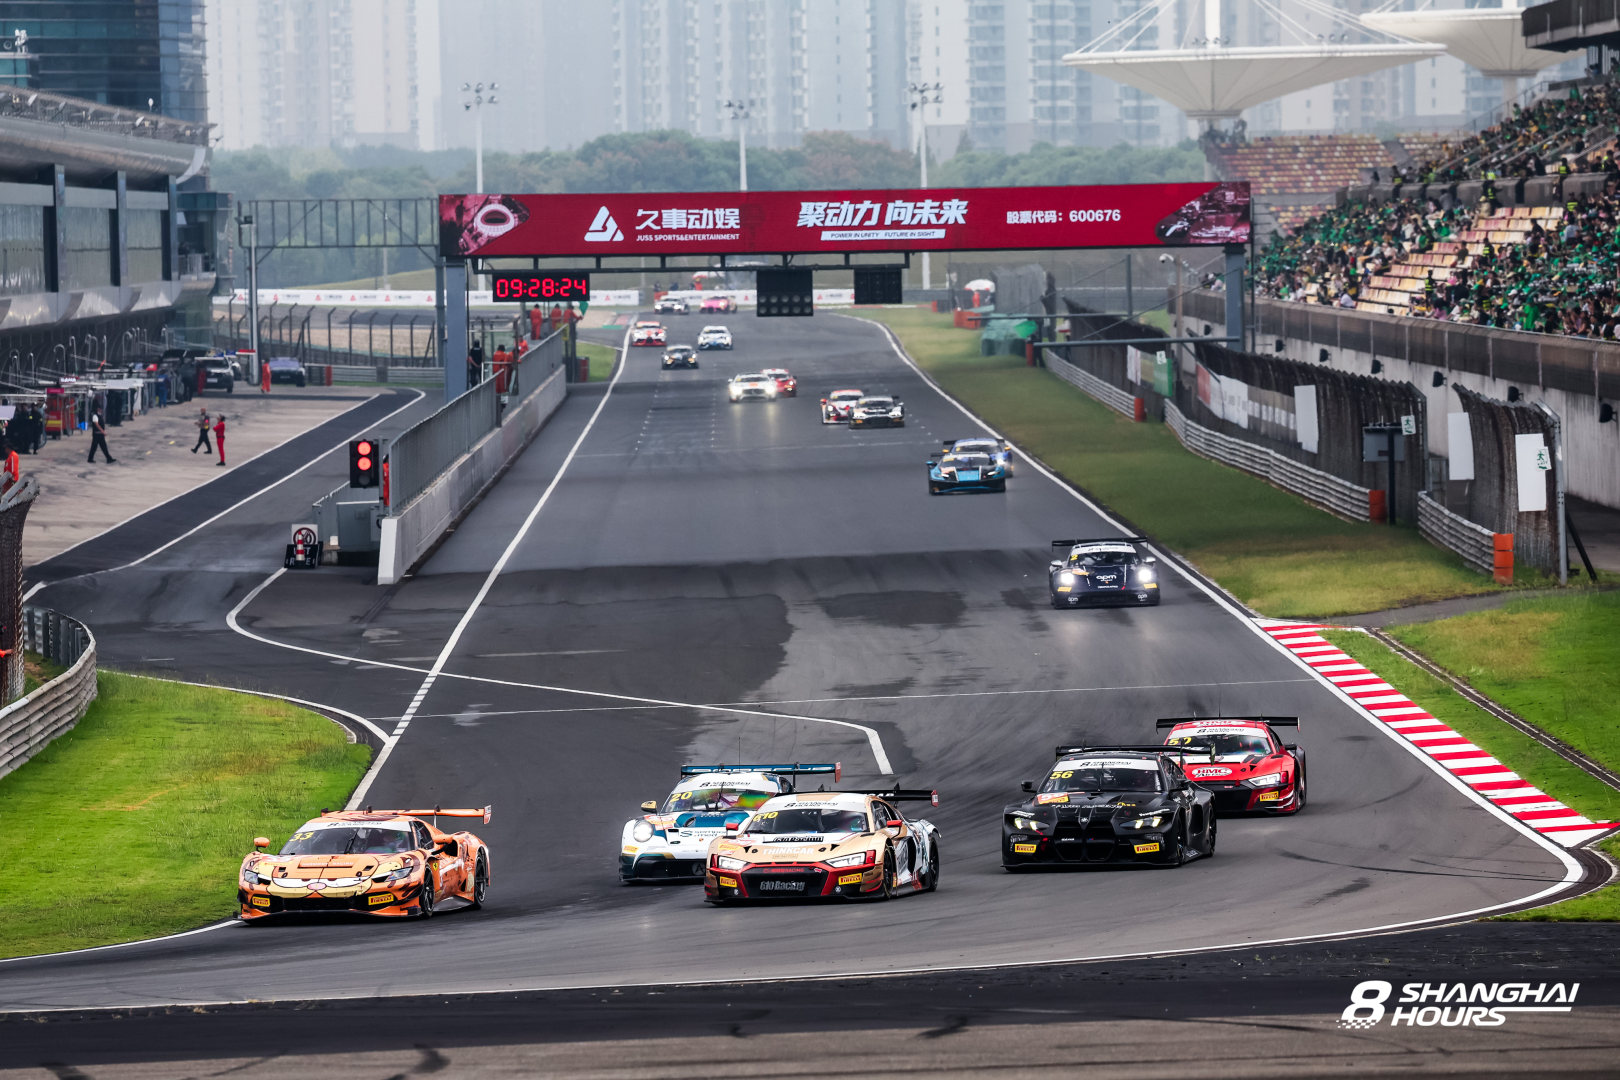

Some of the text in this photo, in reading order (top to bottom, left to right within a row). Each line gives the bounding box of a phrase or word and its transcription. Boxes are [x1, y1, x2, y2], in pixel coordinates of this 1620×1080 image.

[797, 198, 968, 227] 聚动力 向未来
[635, 208, 741, 230] 久事动娱
[636, 234, 653, 242] JUSS
[496, 278, 587, 298] 09:28:24
[1049, 770, 1074, 780] 56
[669, 791, 693, 803] 20
[753, 811, 779, 822] 610
[288, 831, 315, 842] 33
[762, 847, 815, 855] THINKCAR
[1136, 844, 1158, 852] PIRELLI
[760, 880, 774, 891] 610
